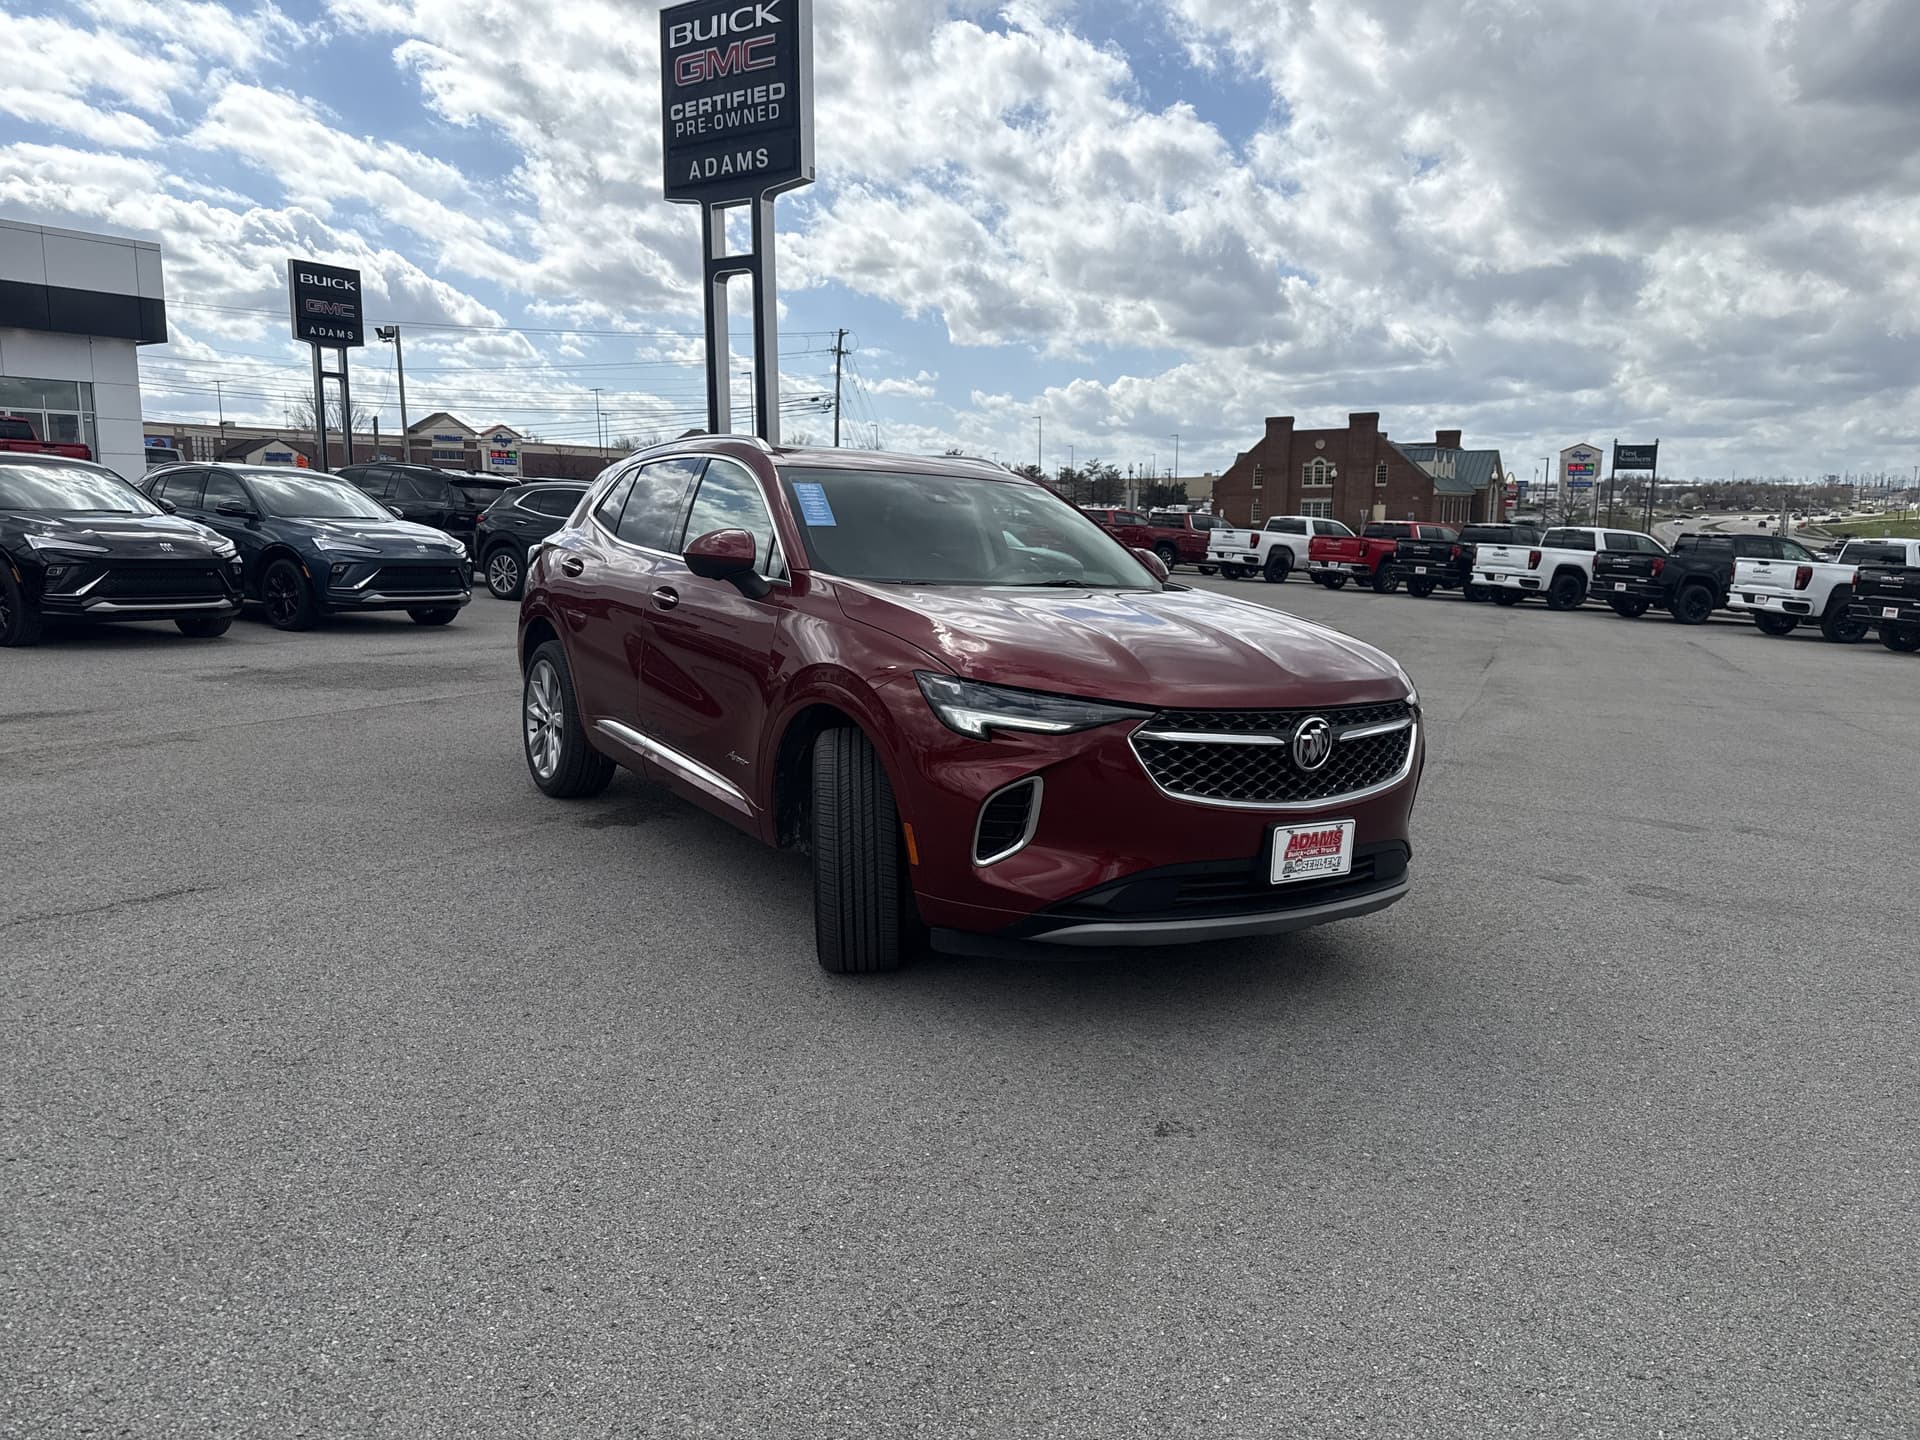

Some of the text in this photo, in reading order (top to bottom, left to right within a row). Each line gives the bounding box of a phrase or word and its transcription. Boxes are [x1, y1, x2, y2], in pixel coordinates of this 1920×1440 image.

[669, 0, 783, 48] BUICK
[675, 33, 776, 86] GMC
[670, 82, 786, 121] CERTIFIED
[675, 103, 780, 138] PRE-OWNED
[689, 148, 769, 180] ADAMS
[300, 273, 356, 291] BUICK
[306, 299, 355, 318] GMC
[310, 326, 354, 340] ADAMS
[1287, 829, 1343, 850] ADAMS
